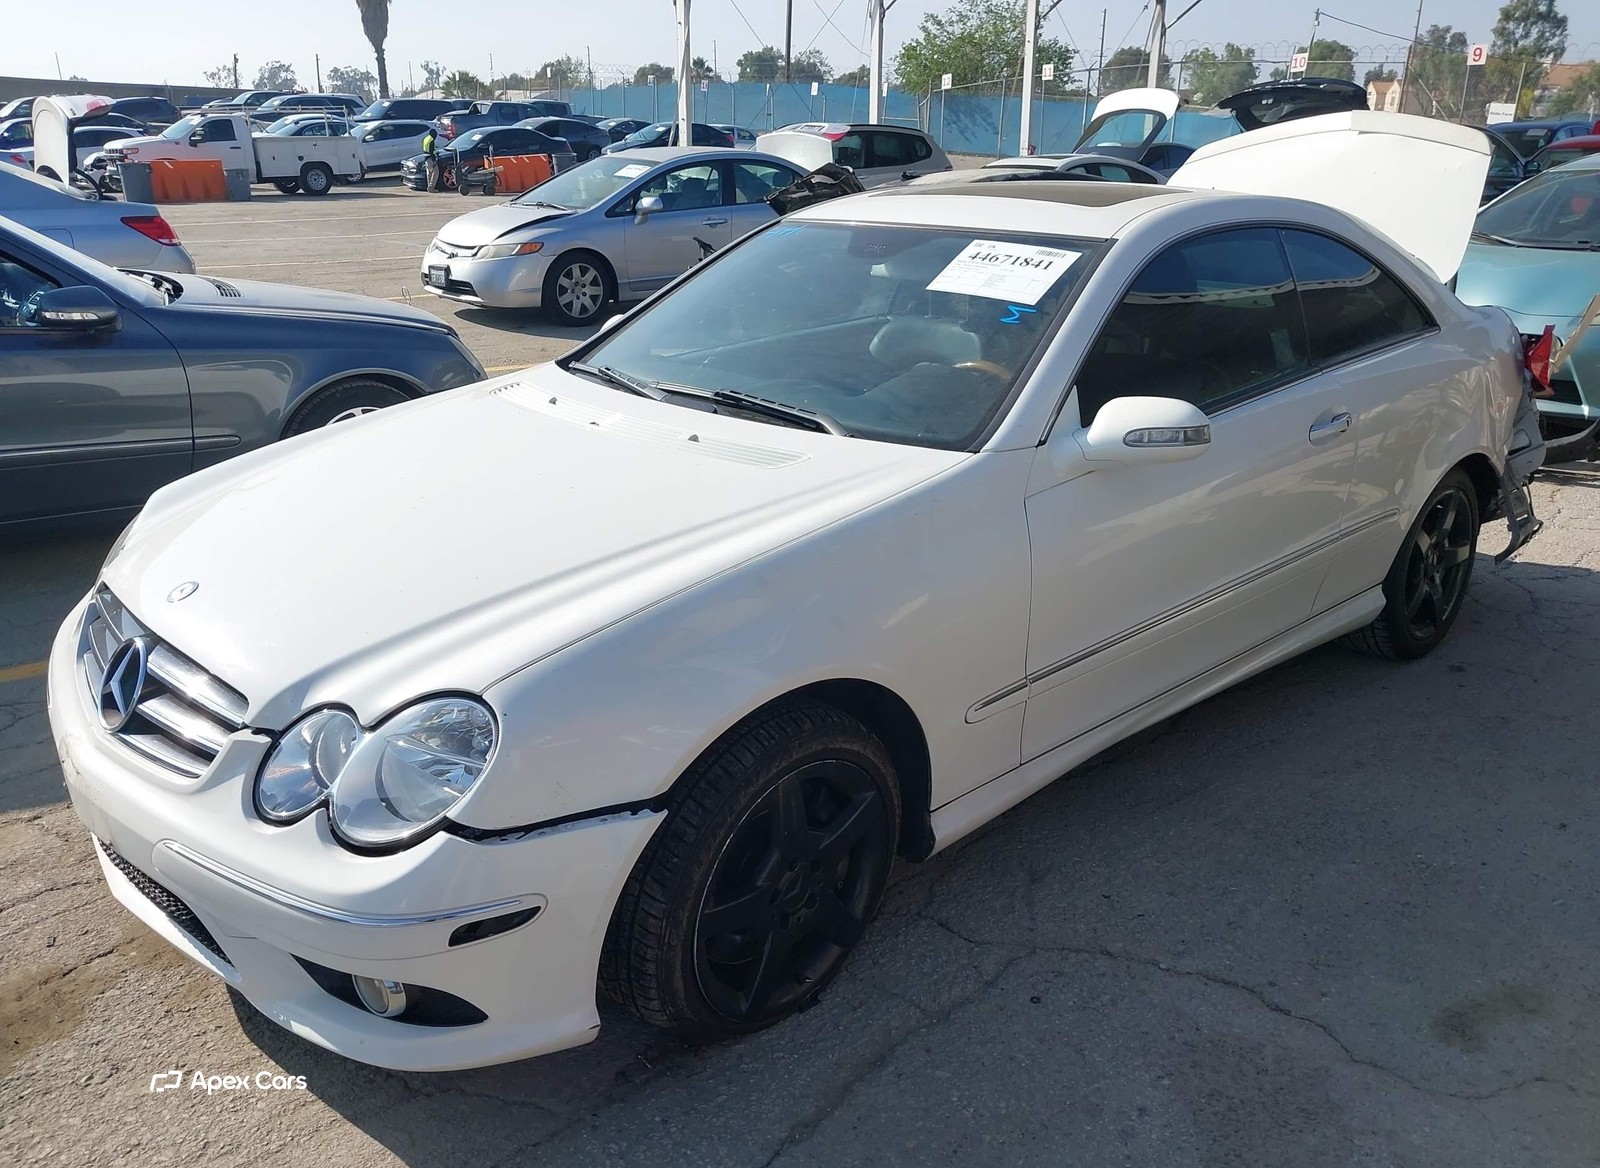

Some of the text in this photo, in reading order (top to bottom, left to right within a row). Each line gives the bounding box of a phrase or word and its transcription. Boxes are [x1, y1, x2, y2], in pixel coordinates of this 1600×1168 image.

[1472, 47, 1483, 62] 9
[1291, 56, 1307, 69] 10
[1043, 67, 1053, 78] 11
[942, 77, 951, 87] 12
[968, 251, 1054, 270] 44671841
